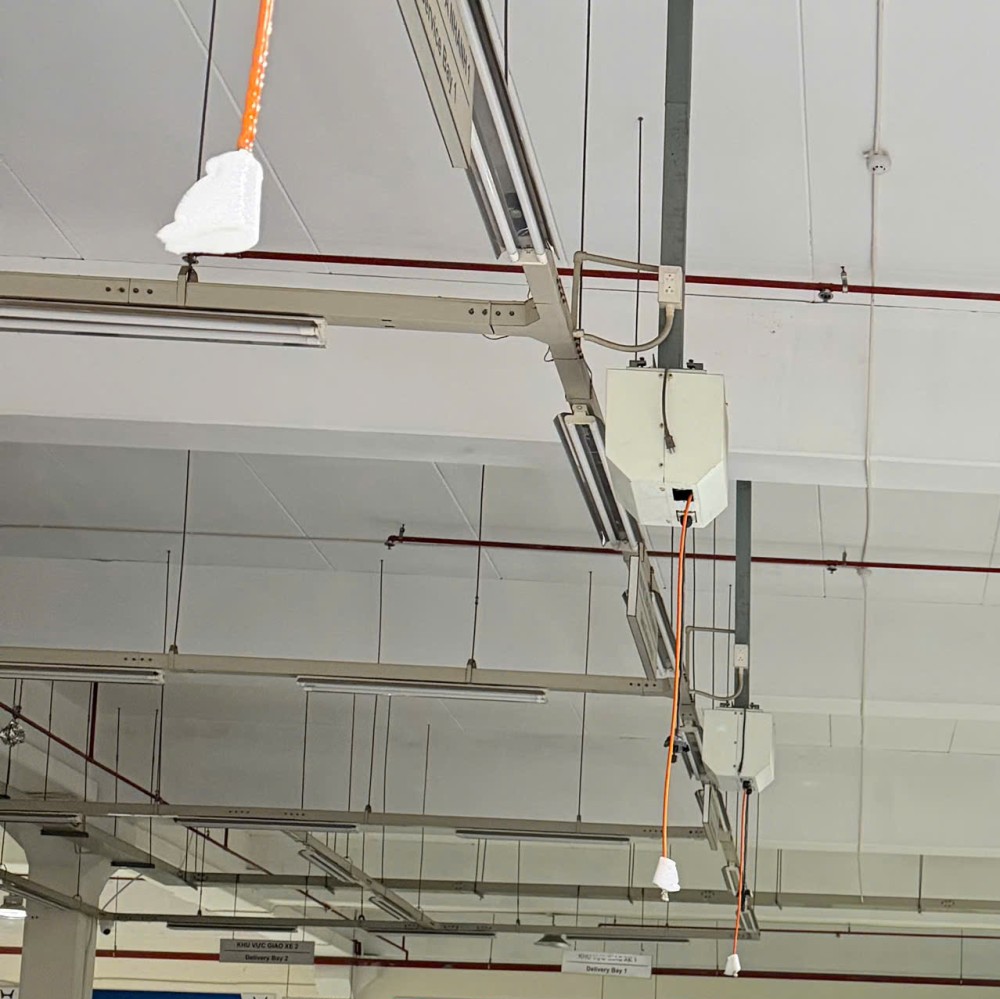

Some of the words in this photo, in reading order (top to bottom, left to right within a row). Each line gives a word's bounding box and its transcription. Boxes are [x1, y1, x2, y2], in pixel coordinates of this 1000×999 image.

[422, 0, 441, 56] ervice
[245, 954, 269, 962] Delivery
[586, 966, 610, 974] Delivery
[611, 967, 623, 975] Bay
